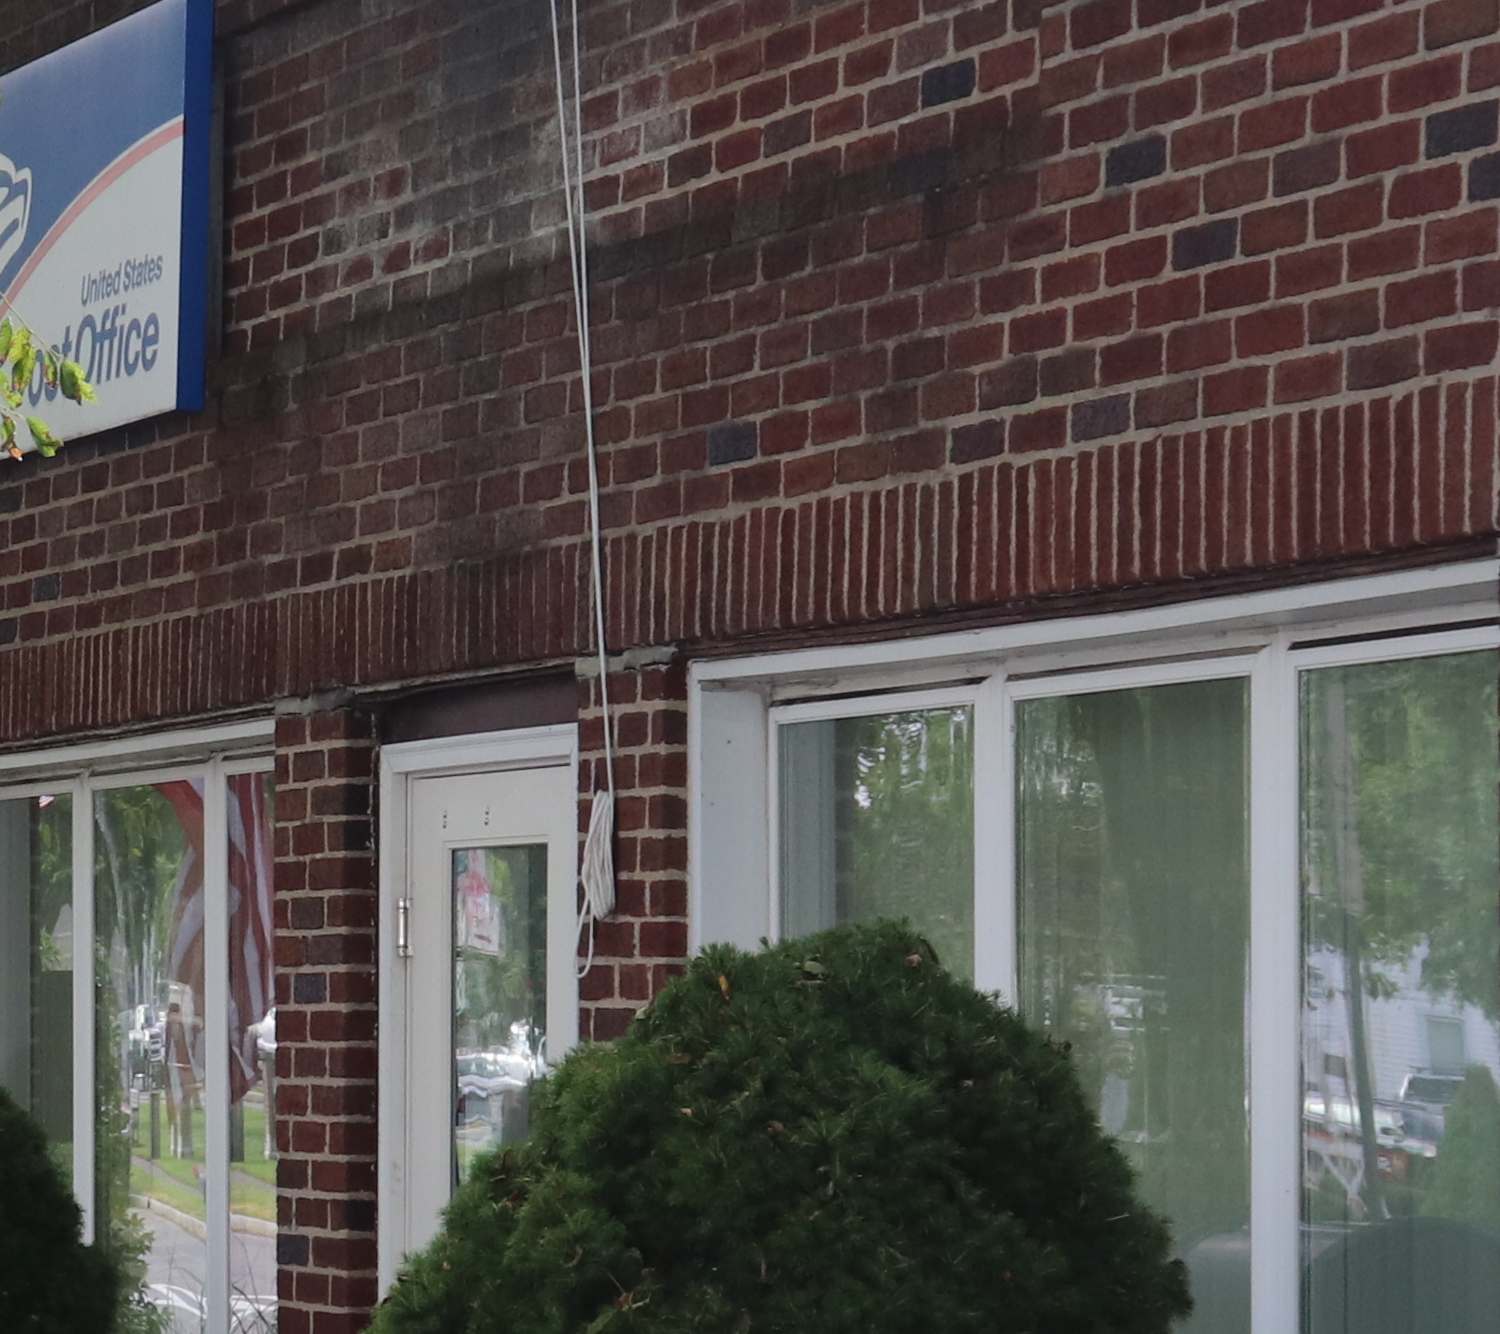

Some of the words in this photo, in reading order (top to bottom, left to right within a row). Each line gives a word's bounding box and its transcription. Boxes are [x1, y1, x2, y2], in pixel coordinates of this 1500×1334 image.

[81, 263, 121, 307] United
[123, 253, 163, 293] States
[27, 324, 73, 408] ost
[75, 302, 160, 385] Office
